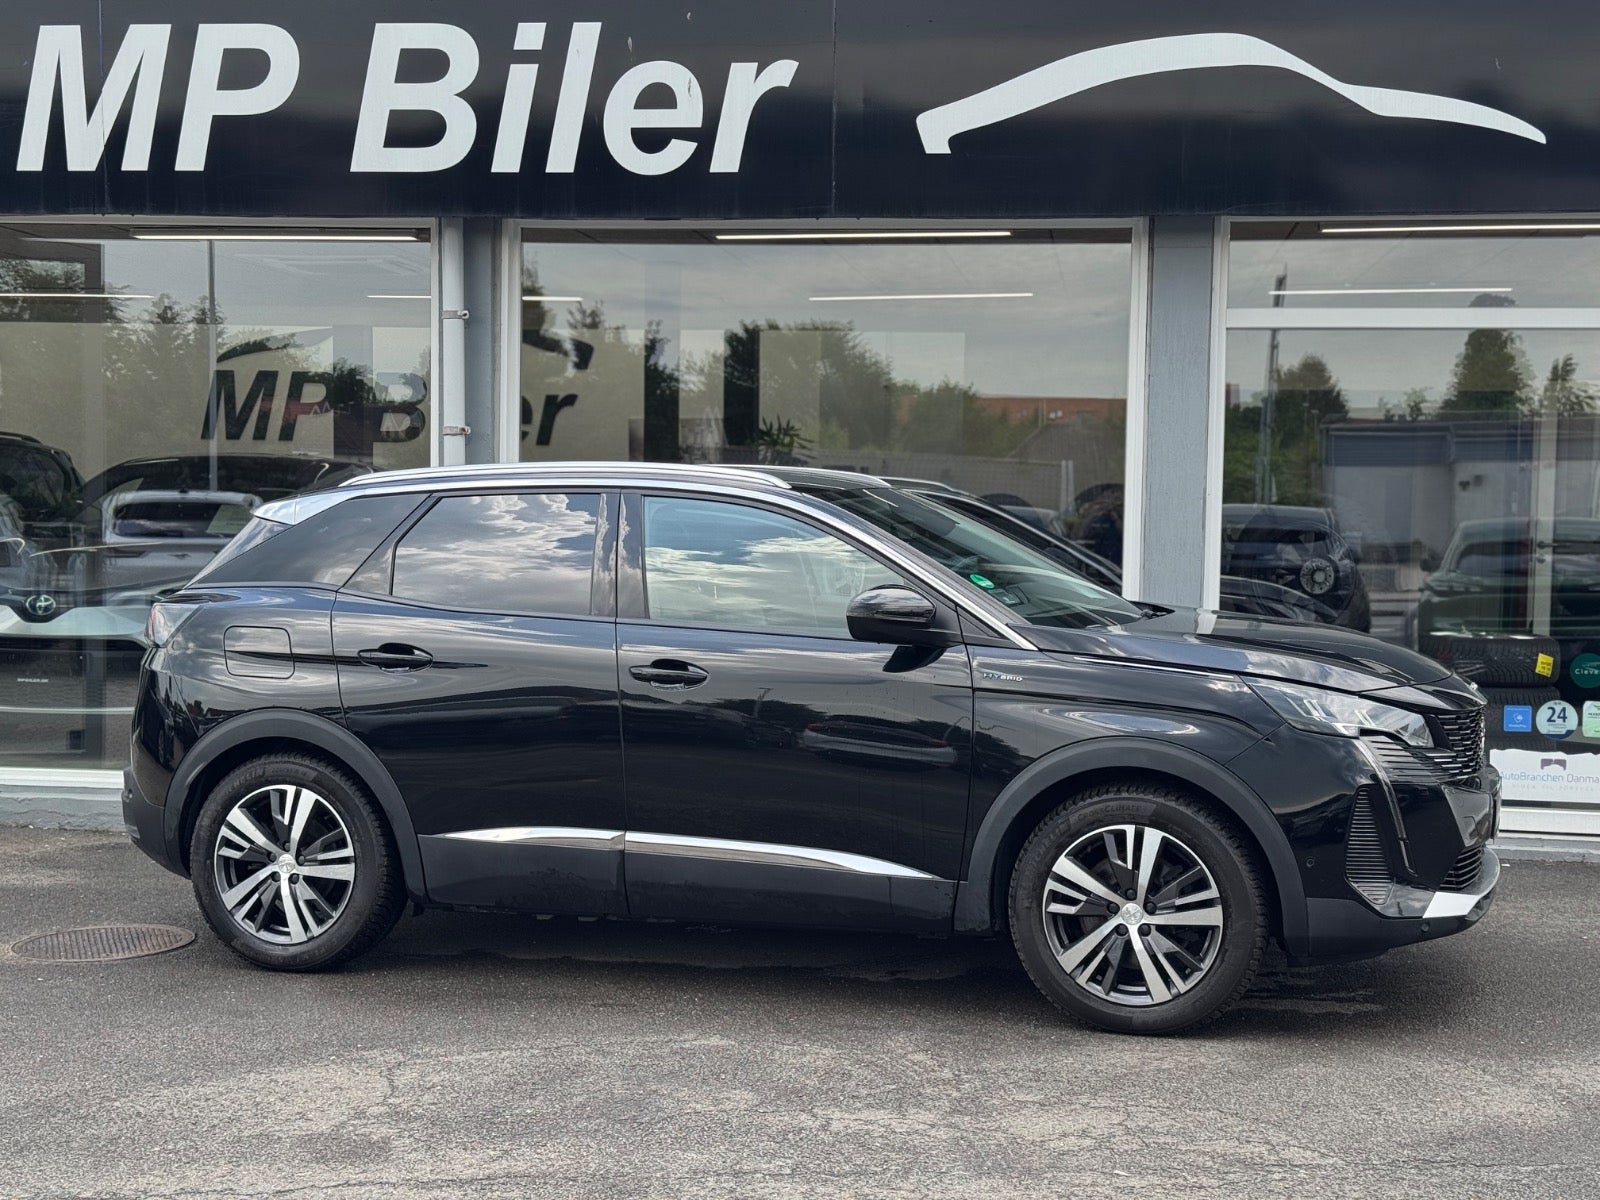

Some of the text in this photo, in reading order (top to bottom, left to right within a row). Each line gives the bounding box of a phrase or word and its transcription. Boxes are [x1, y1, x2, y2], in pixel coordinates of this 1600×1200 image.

[16, 22, 800, 176] MP Biler
[201, 369, 334, 441] MP
[983, 672, 1023, 682] HYBRID
[1546, 706, 1568, 723] 24
